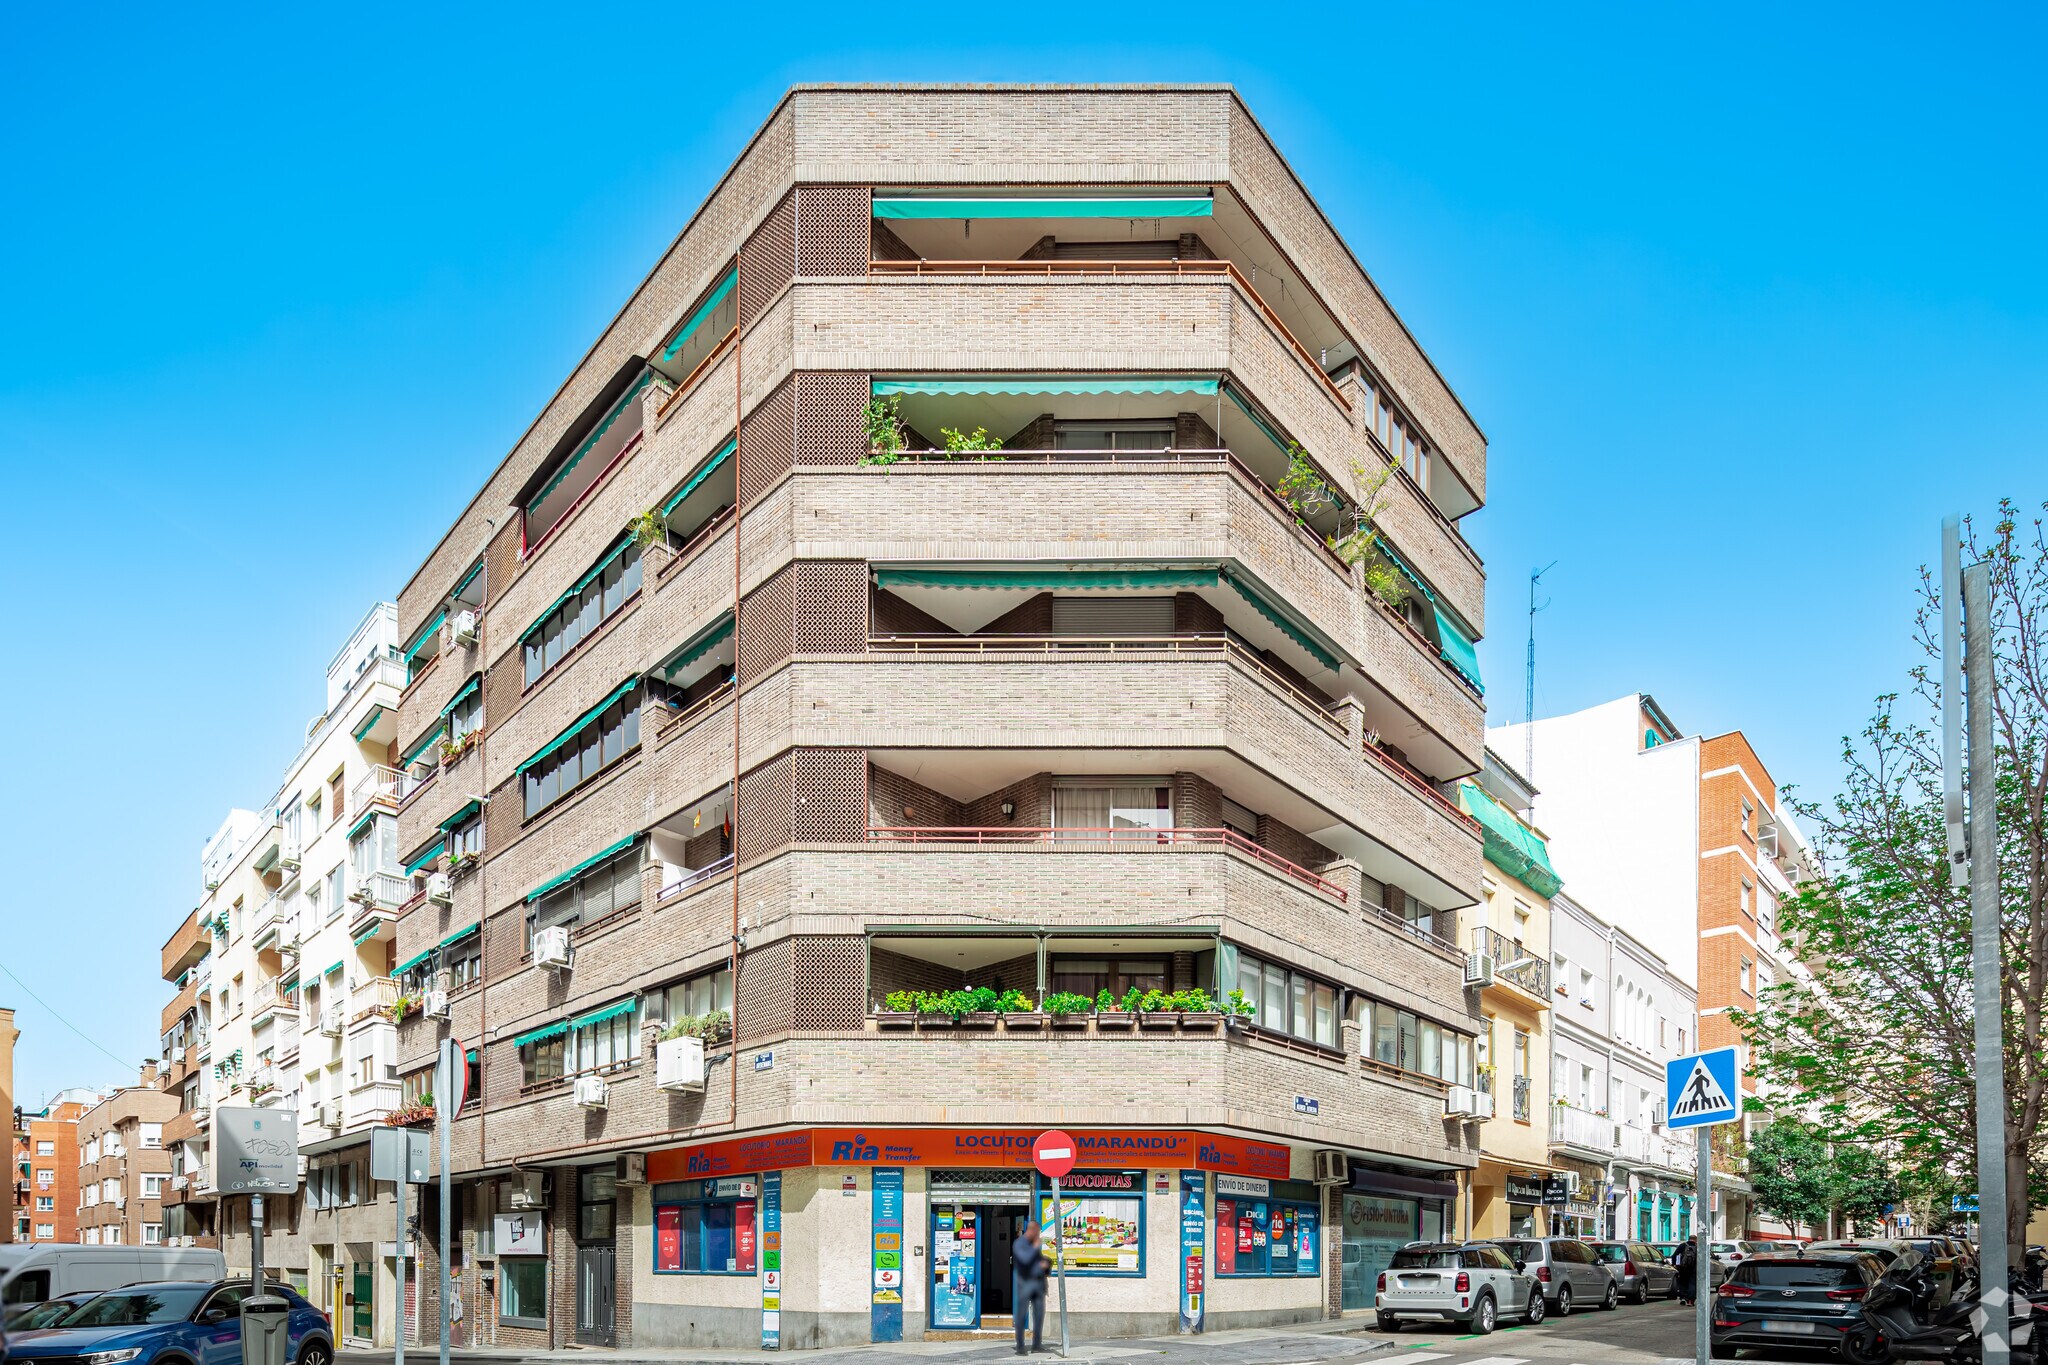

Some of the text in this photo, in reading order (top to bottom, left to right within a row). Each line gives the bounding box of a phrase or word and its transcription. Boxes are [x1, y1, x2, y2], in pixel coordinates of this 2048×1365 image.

[831, 1134, 880, 1161] Ria
[885, 1145, 914, 1154] Money
[1199, 1141, 1221, 1164] Ria
[687, 1150, 711, 1173] Ria
[885, 1154, 922, 1162] Transfer
[718, 1182, 732, 1192] ENVÍO
[1050, 1174, 1133, 1188] OTOCOPIAS
[1218, 1178, 1267, 1193] ENVÍO DE DINERO
[1271, 1214, 1283, 1229] ria
[1362, 1206, 1409, 1225] FISIOPUNTURA
